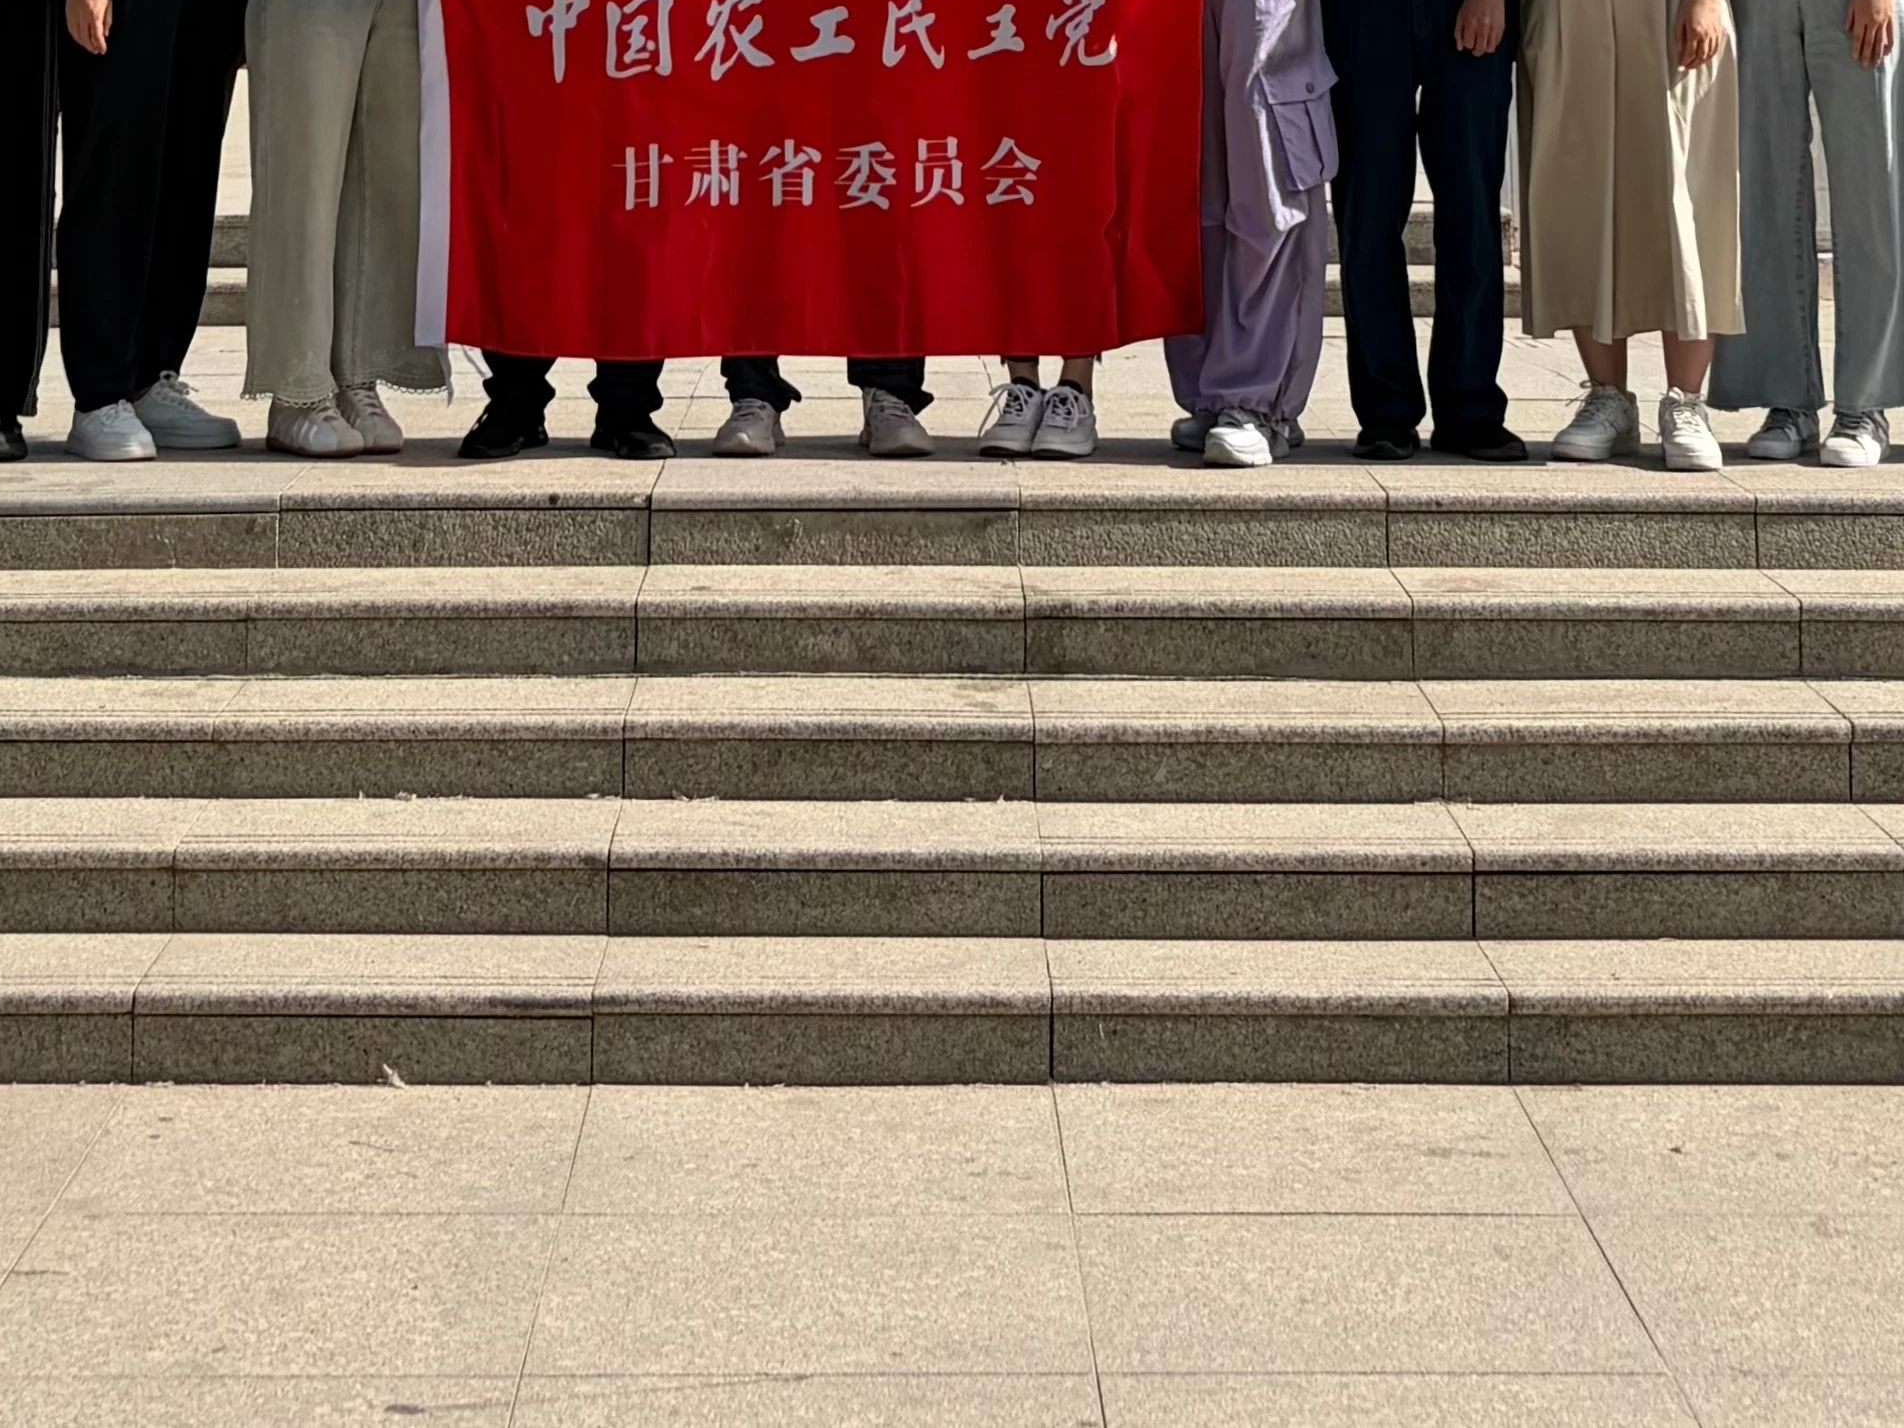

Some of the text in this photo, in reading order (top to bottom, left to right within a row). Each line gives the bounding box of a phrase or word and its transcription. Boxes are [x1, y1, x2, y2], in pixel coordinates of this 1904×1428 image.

[612, 136, 1042, 211] 甘肃省委员会
